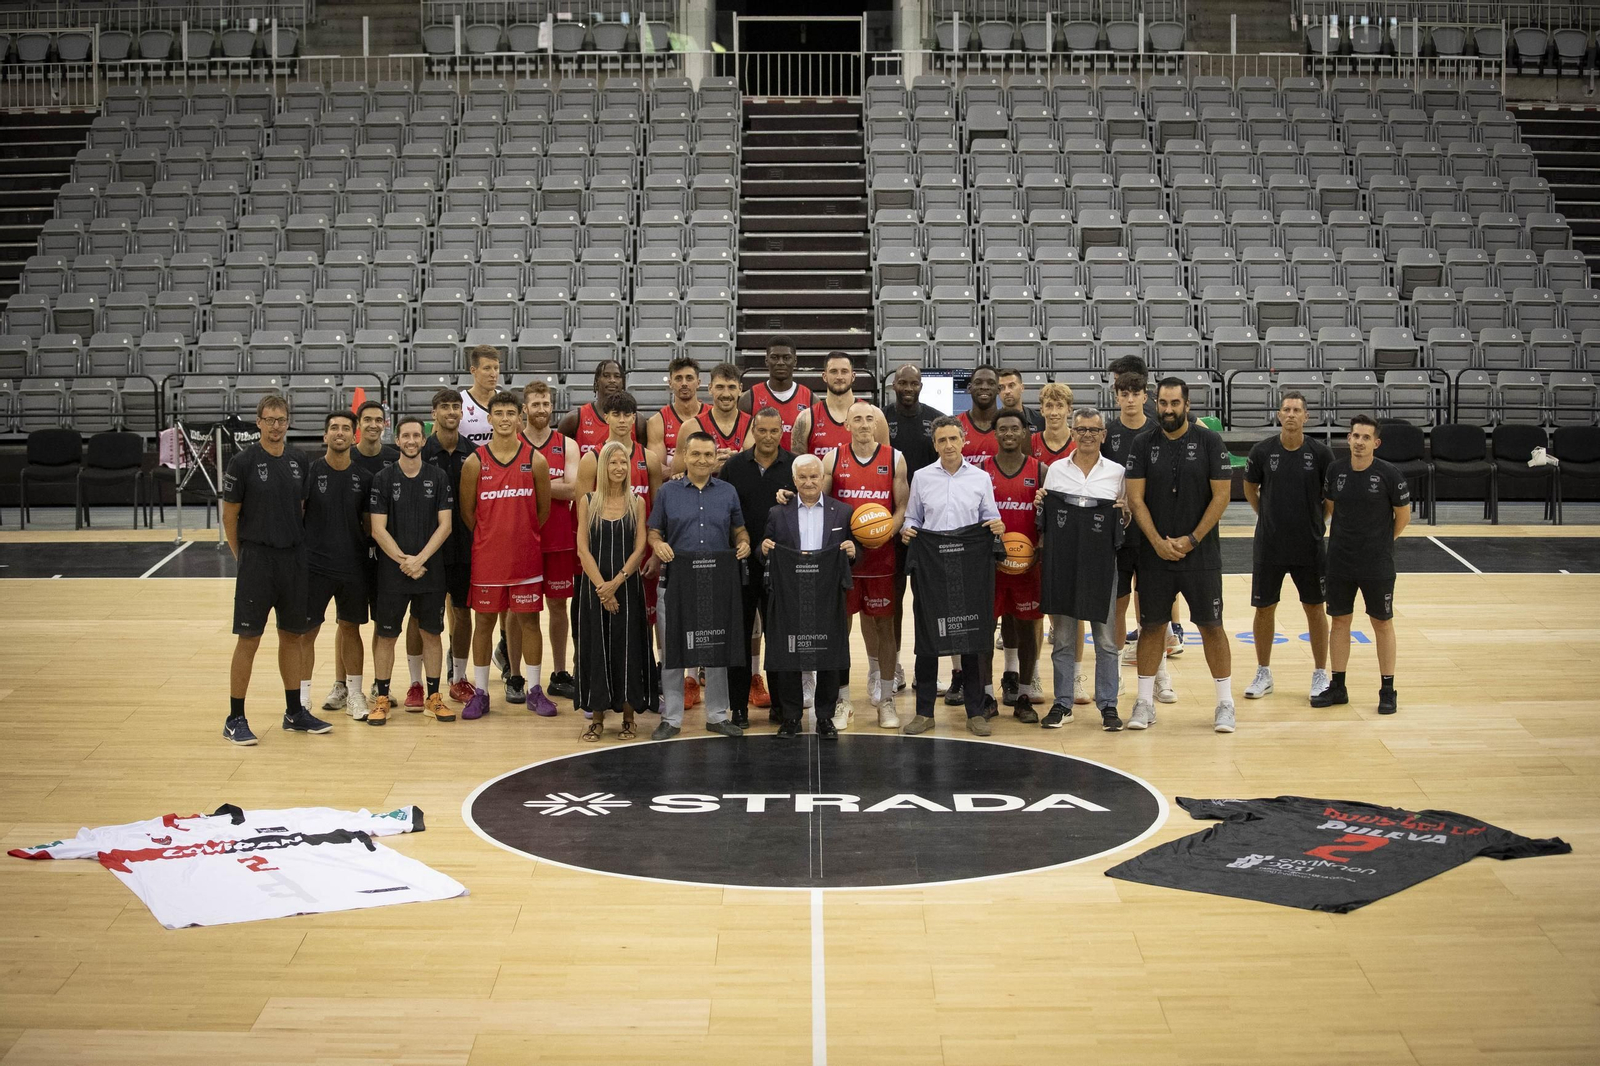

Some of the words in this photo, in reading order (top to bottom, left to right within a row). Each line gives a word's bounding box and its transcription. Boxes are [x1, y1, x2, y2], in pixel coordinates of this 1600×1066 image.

[859, 511, 887, 523] Wilson
[648, 793, 1111, 814] STRADA
[1303, 833, 1389, 863] 2
